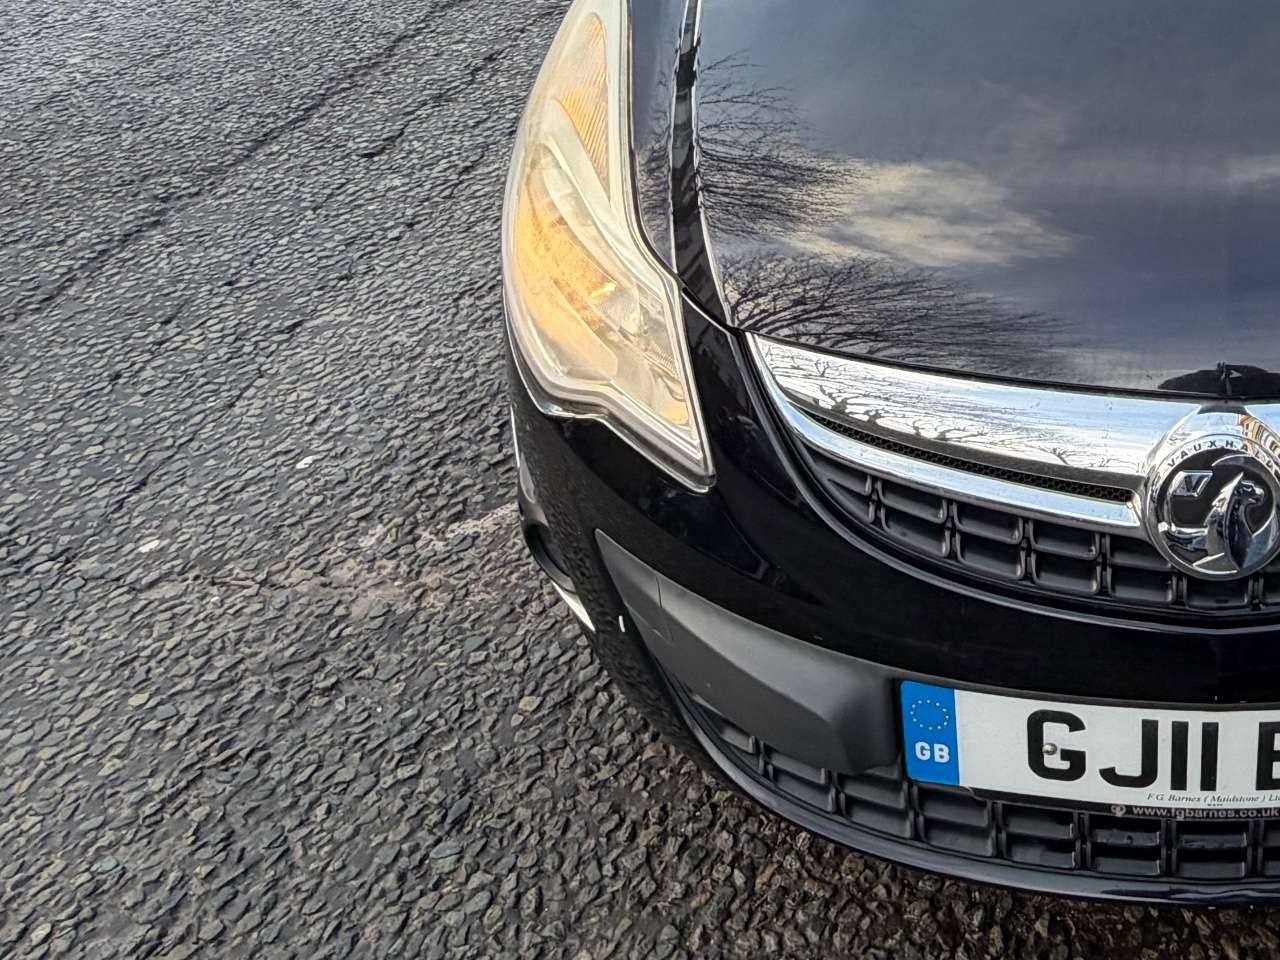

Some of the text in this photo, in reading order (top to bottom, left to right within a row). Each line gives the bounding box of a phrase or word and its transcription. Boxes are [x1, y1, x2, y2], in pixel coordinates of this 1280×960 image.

[914, 741, 950, 763] GB
[1026, 709, 1220, 792] GJ11
[1168, 794, 1201, 802] Barnes
[1133, 806, 1279, 821] www.fgbarnes.co.uk
